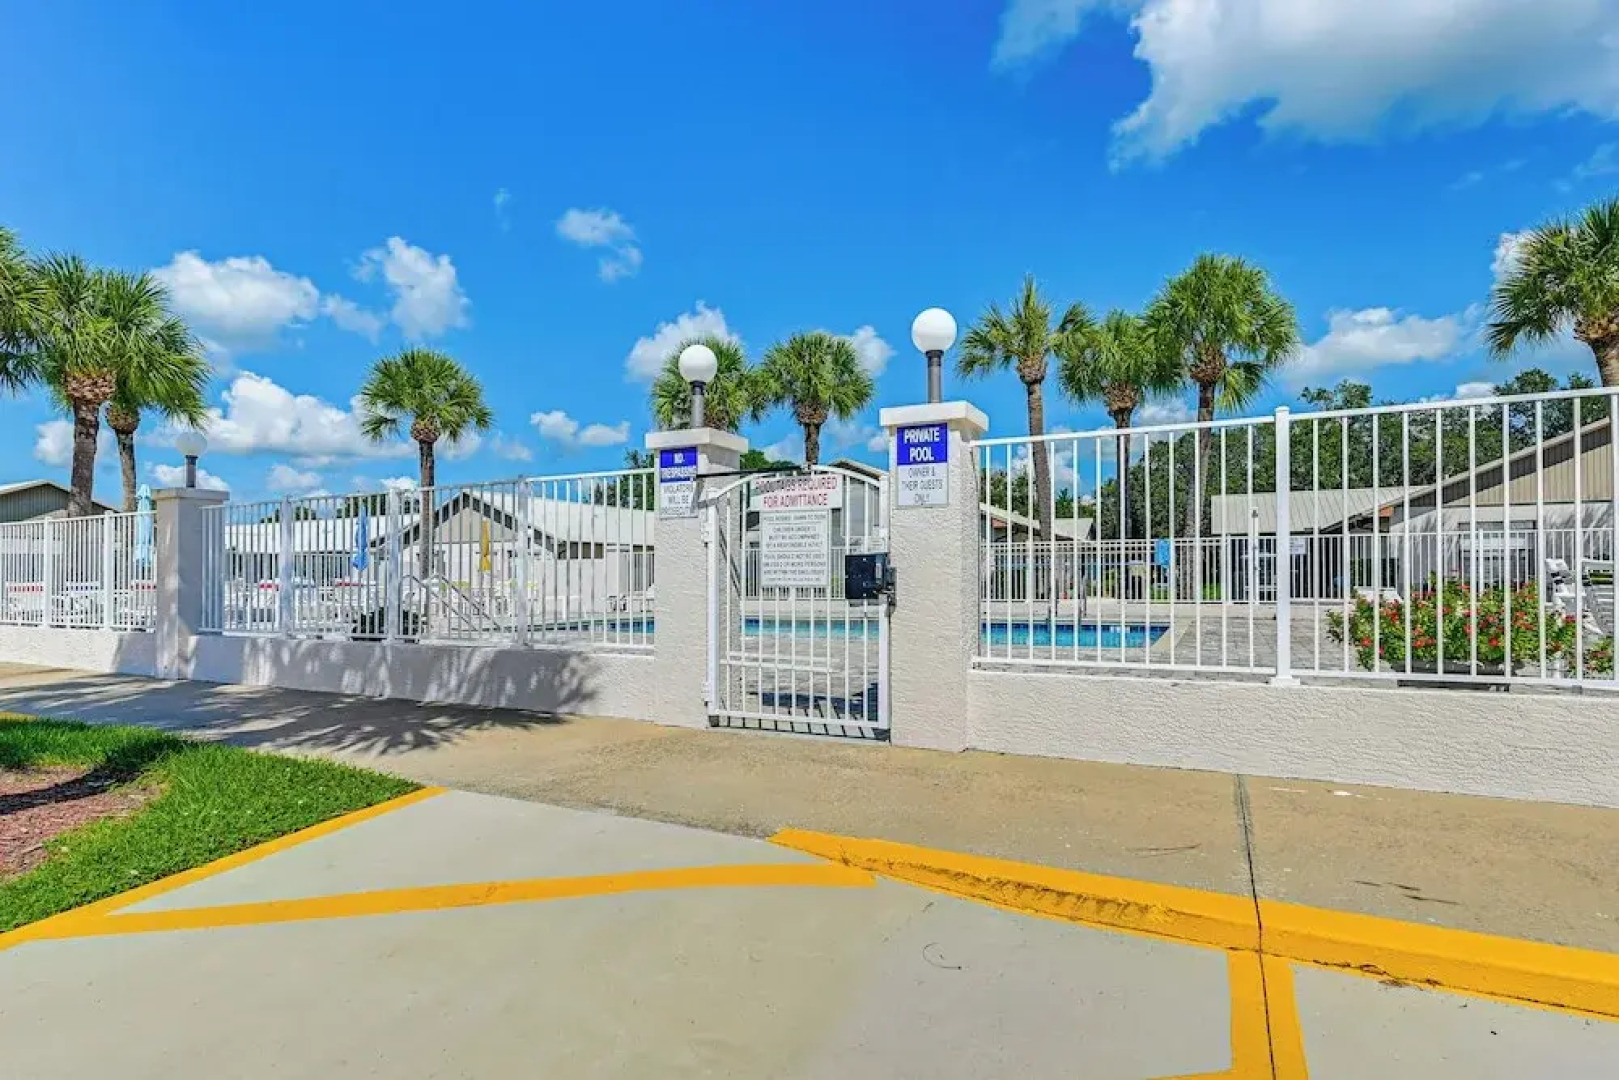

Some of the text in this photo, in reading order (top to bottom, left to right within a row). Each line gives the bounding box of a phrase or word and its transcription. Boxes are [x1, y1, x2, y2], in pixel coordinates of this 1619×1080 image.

[904, 427, 940, 443] PRIVATE
[909, 446, 935, 462] POOL
[908, 466, 930, 478] OWNER
[798, 475, 838, 491] REQUIRED
[901, 479, 944, 491] THEIR GUESTS
[763, 493, 829, 508] FOR ADMITTANCE
[914, 493, 931, 504] ONLY
